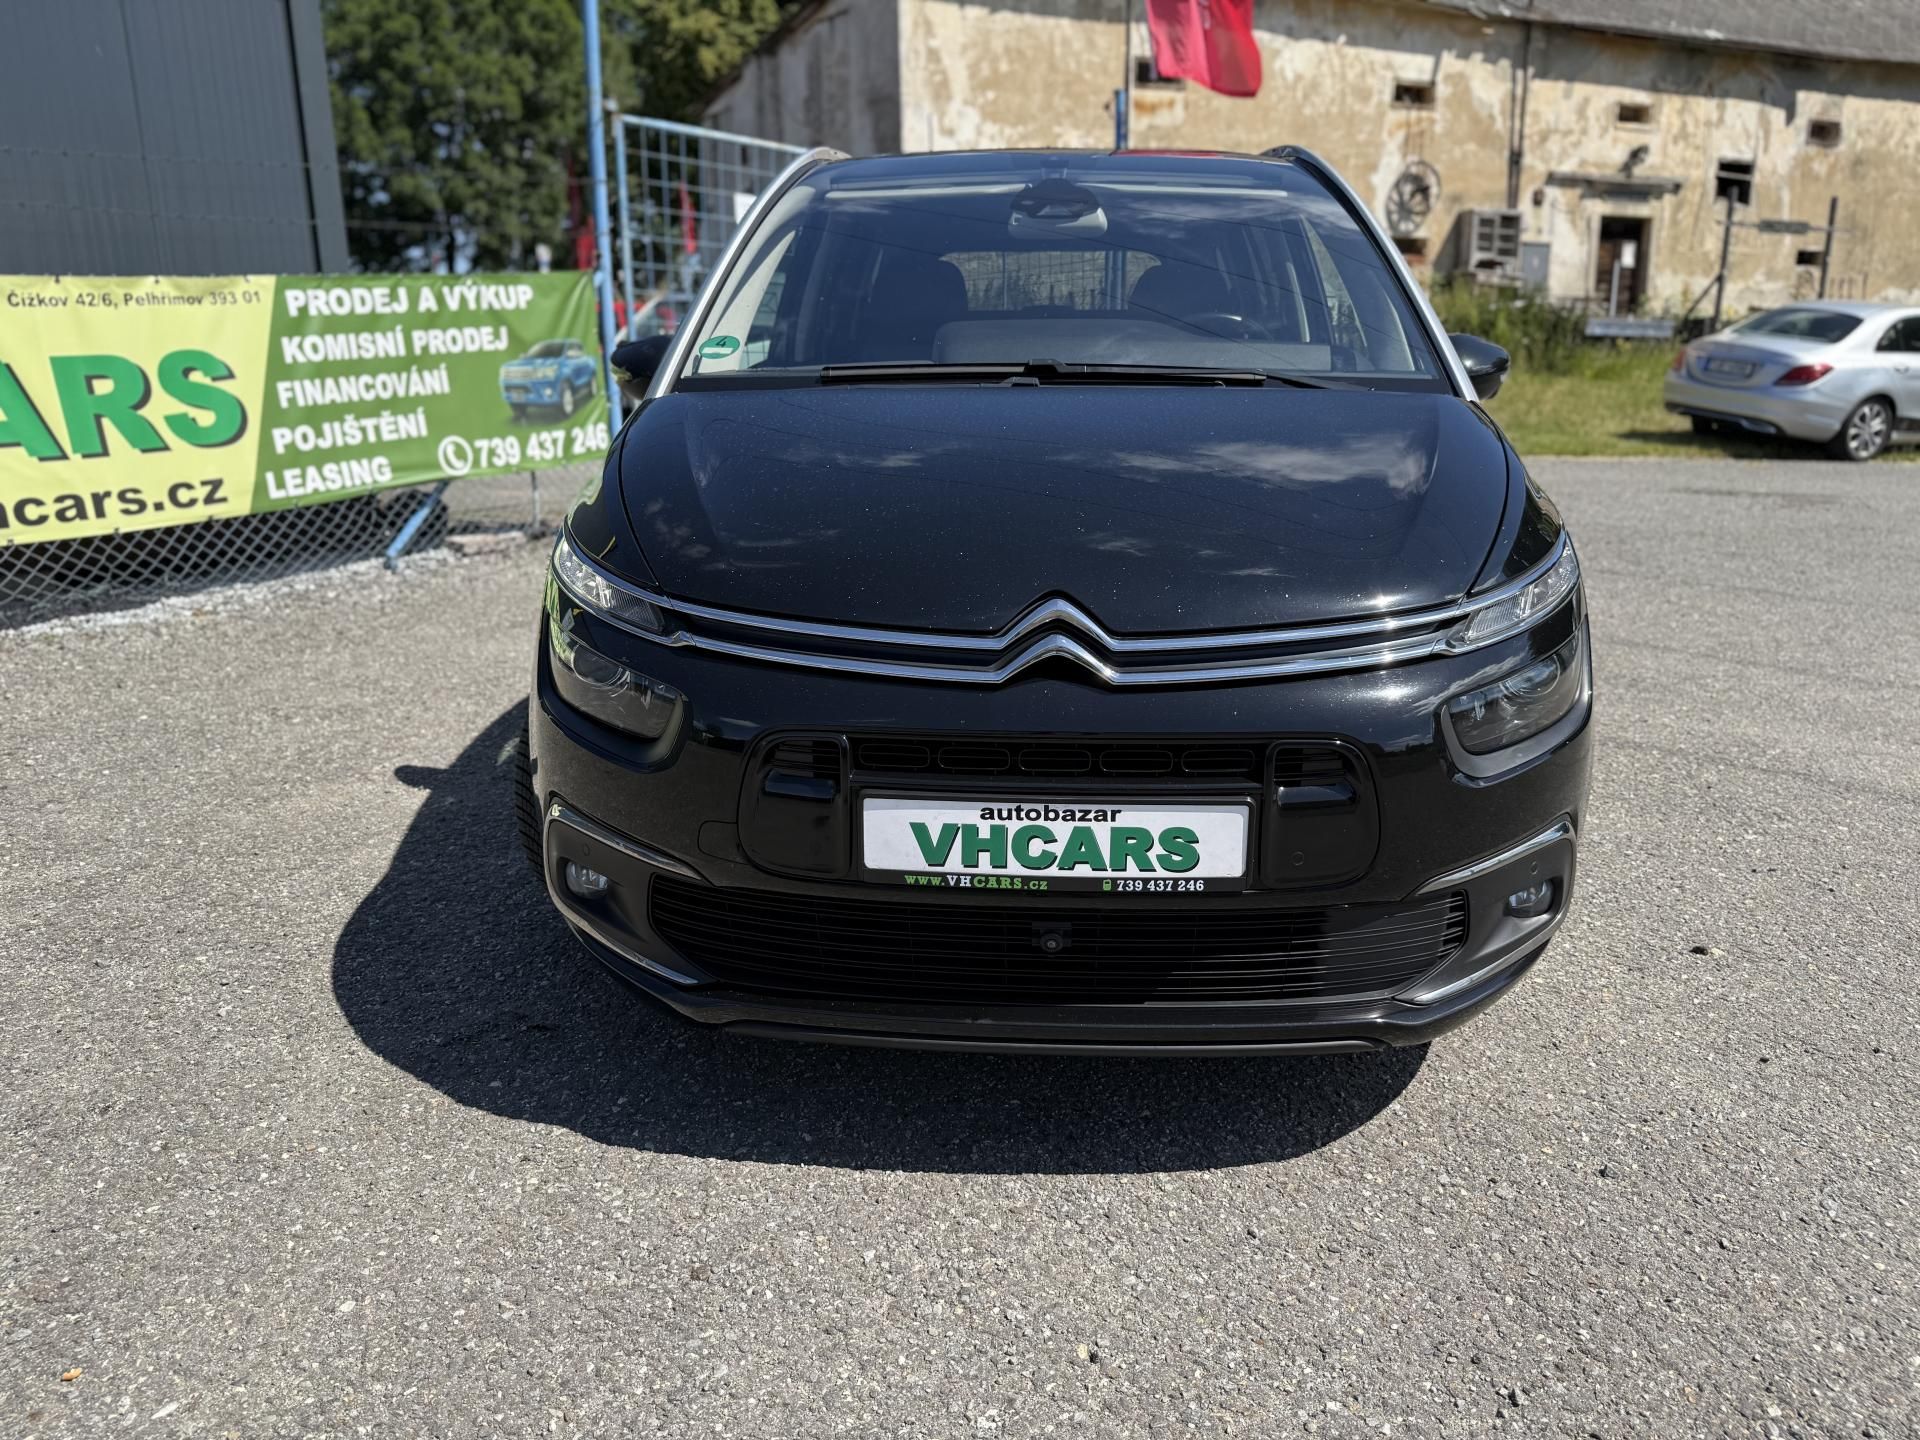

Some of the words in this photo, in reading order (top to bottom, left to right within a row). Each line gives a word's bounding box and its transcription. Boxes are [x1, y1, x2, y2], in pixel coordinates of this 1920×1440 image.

[75, 291, 119, 309] 42/6,
[209, 290, 238, 306] 393
[243, 290, 261, 304] 01
[285, 286, 409, 317] PRODEJ
[418, 287, 438, 313] A
[443, 281, 534, 311] VÝKUP
[281, 325, 406, 364] KOMISNÍ
[412, 326, 509, 356] PRODEJ
[276, 363, 450, 408] FINANCOVÁNÍ
[272, 407, 427, 454] POJIŠTĚNÍ
[474, 435, 522, 468] 739
[526, 430, 565, 461] 437
[571, 422, 609, 455] 246
[265, 456, 393, 499] LEASING
[0, 478, 229, 529] cars.cz
[979, 805, 1122, 822] autobazar
[909, 822, 1200, 873] VHCARS
[1117, 879, 1143, 892] 739
[1147, 879, 1174, 892] 437
[1178, 879, 1204, 892] 246
